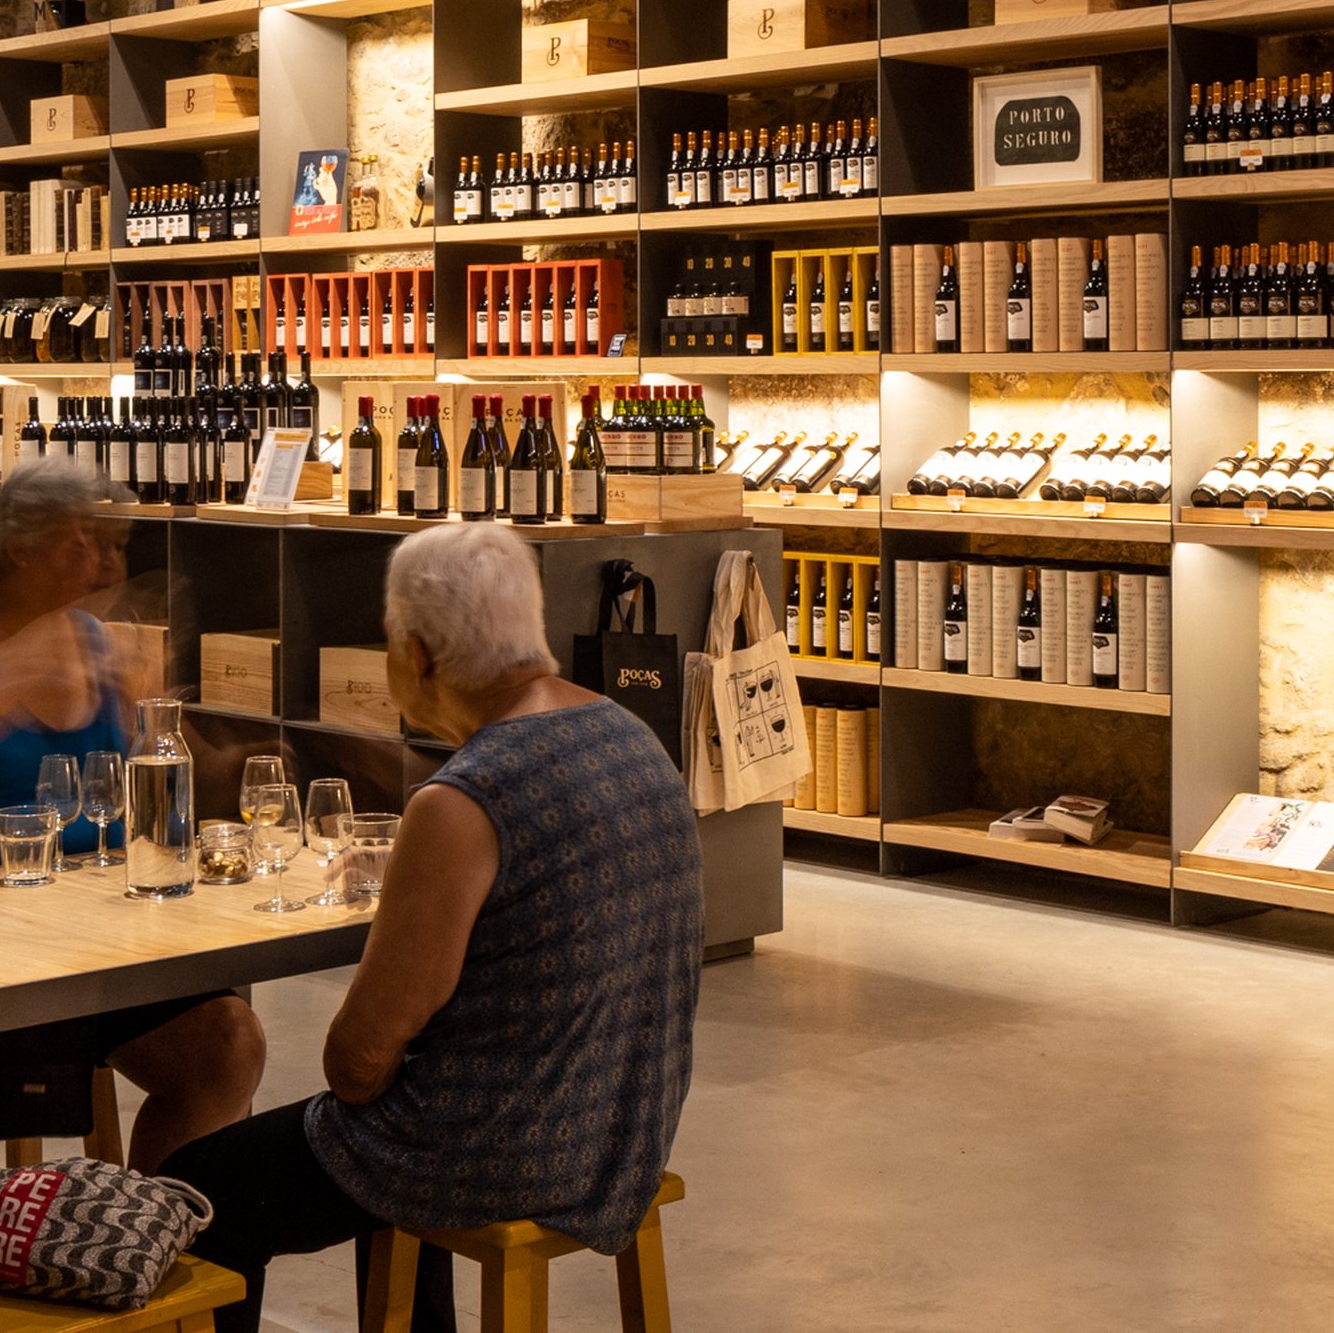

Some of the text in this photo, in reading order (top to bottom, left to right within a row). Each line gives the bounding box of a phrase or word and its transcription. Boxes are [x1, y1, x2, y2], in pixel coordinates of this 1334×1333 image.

[1009, 107, 1065, 125] PORTO
[1003, 130, 1071, 149] SEGURO
[617, 668, 662, 689] POÇAS
[8, 1172, 57, 1201] PE
